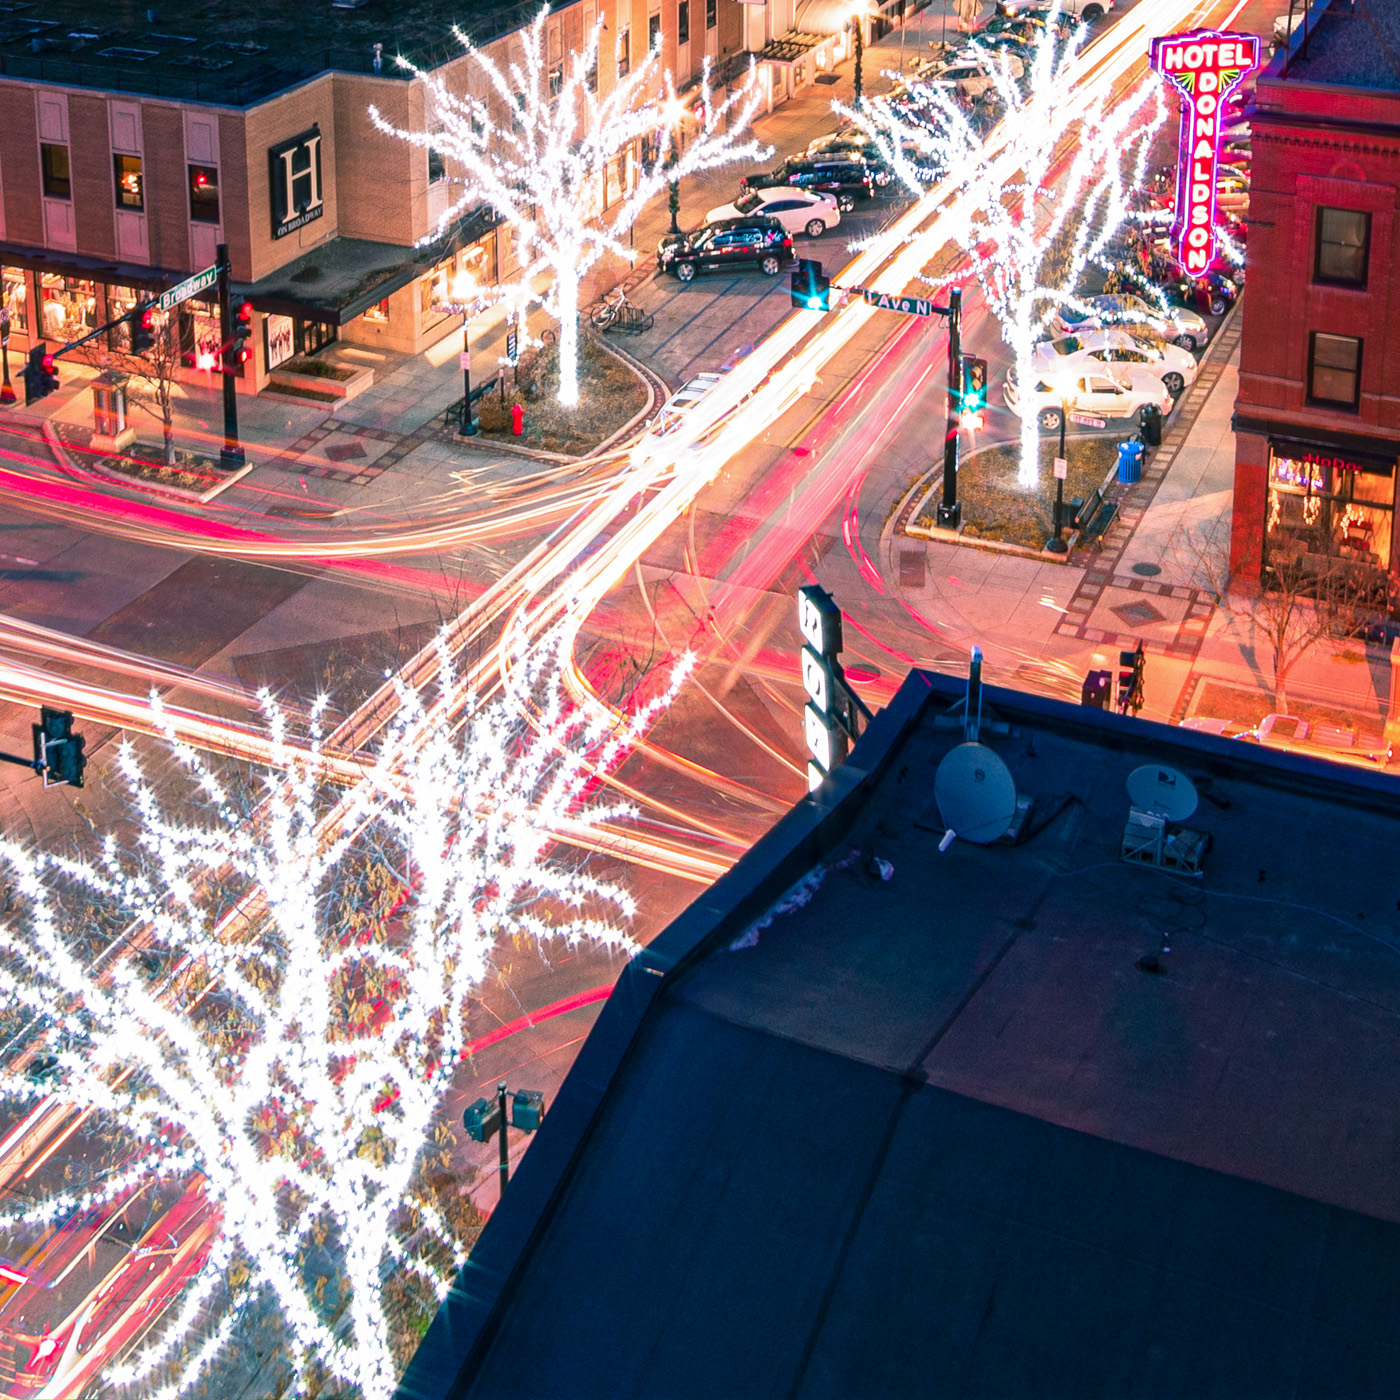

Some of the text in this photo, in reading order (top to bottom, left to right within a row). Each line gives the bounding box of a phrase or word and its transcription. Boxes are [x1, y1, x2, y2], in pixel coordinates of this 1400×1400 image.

[1165, 43, 1252, 70] HOTEL
[280, 136, 323, 224] H
[1188, 72, 1217, 269] DONALDSON
[277, 207, 322, 237] ON BROADWAY
[163, 271, 214, 308] Broadway
[878, 294, 910, 312] Ave
[916, 300, 927, 316] N
